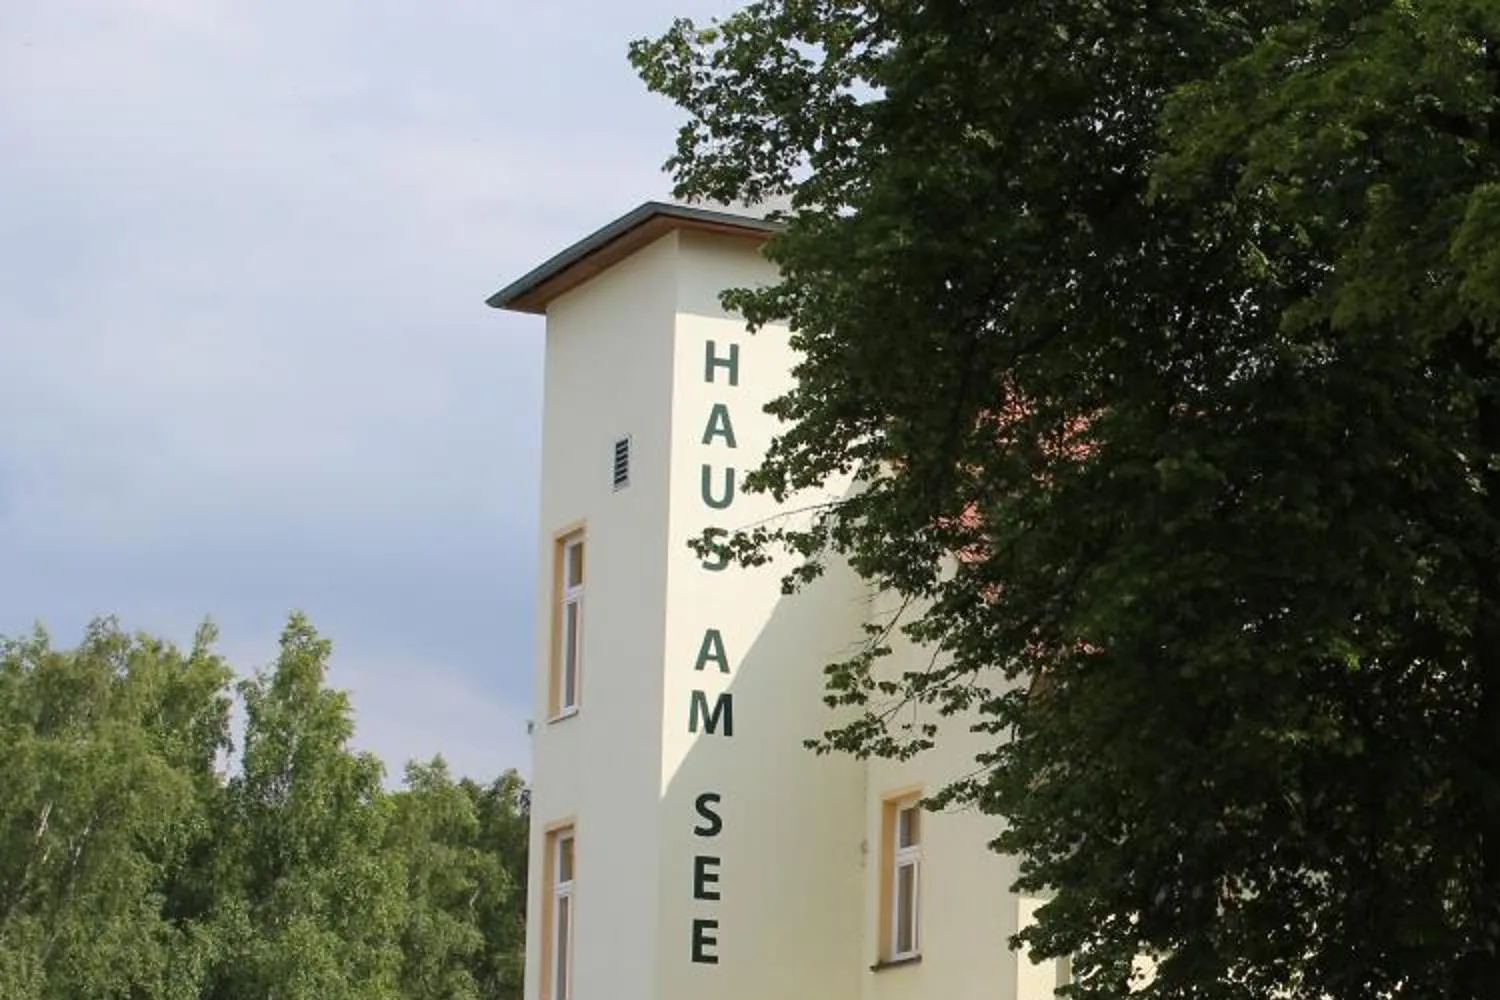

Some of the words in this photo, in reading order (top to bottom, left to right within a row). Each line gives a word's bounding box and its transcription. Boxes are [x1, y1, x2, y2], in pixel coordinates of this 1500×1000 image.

[701, 340, 740, 571] HAUS
[687, 628, 733, 737] AM
[690, 792, 723, 964] SEE
